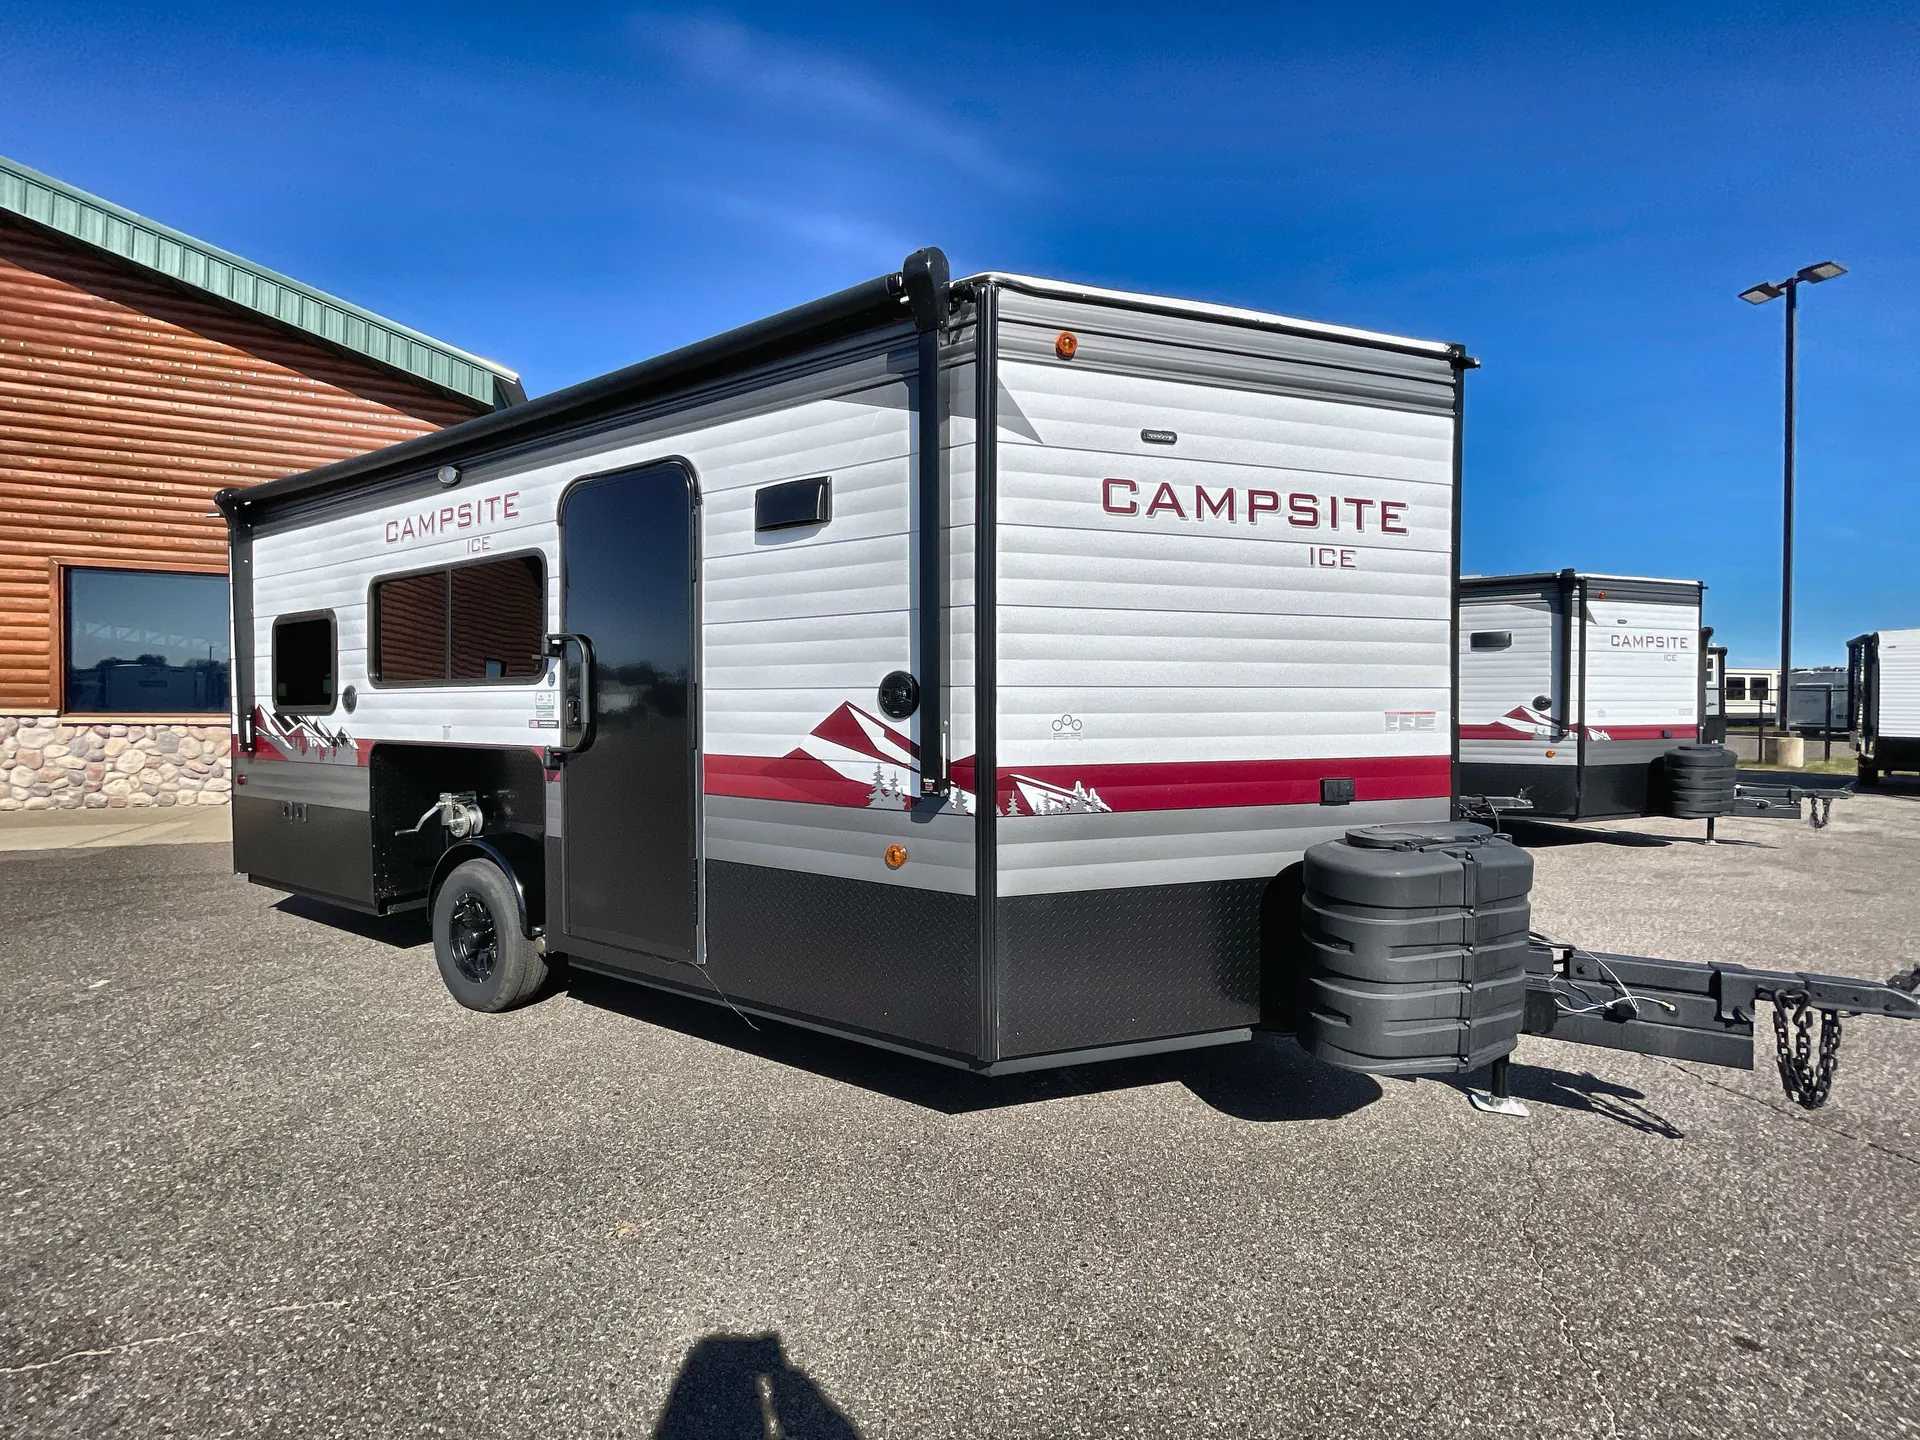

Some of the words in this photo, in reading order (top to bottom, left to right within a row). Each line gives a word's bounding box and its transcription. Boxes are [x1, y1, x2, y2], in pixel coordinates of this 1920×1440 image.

[1102, 478, 1408, 534] CAMPSITE
[386, 491, 519, 543] CAMPSITE
[467, 536, 491, 553] ICE
[1309, 547, 1356, 568] ICE
[1611, 635, 1688, 648] CAMPSITE
